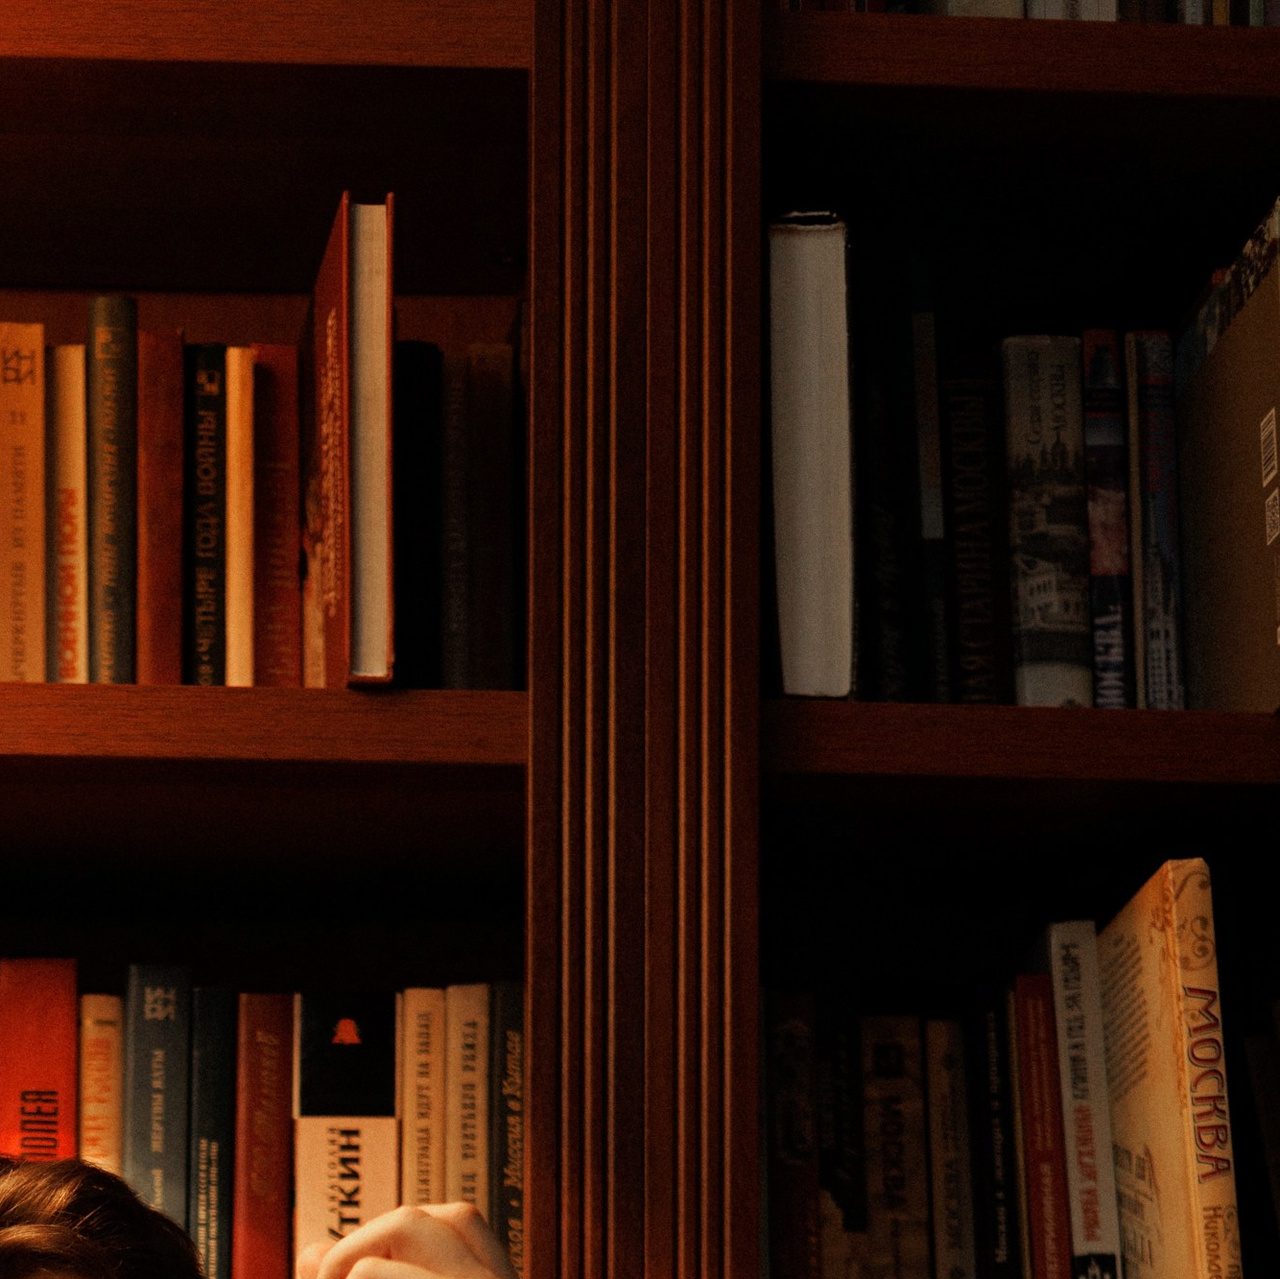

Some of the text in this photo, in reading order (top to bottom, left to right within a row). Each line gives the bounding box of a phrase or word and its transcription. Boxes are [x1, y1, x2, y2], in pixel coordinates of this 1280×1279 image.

[194, 410, 216, 495] ВОЙНЫ
[195, 502, 219, 558] ГОДА
[501, 1031, 521, 1098] Китае
[1183, 984, 1233, 1186] МОСКВА
[502, 1115, 522, 1190] Миссия
